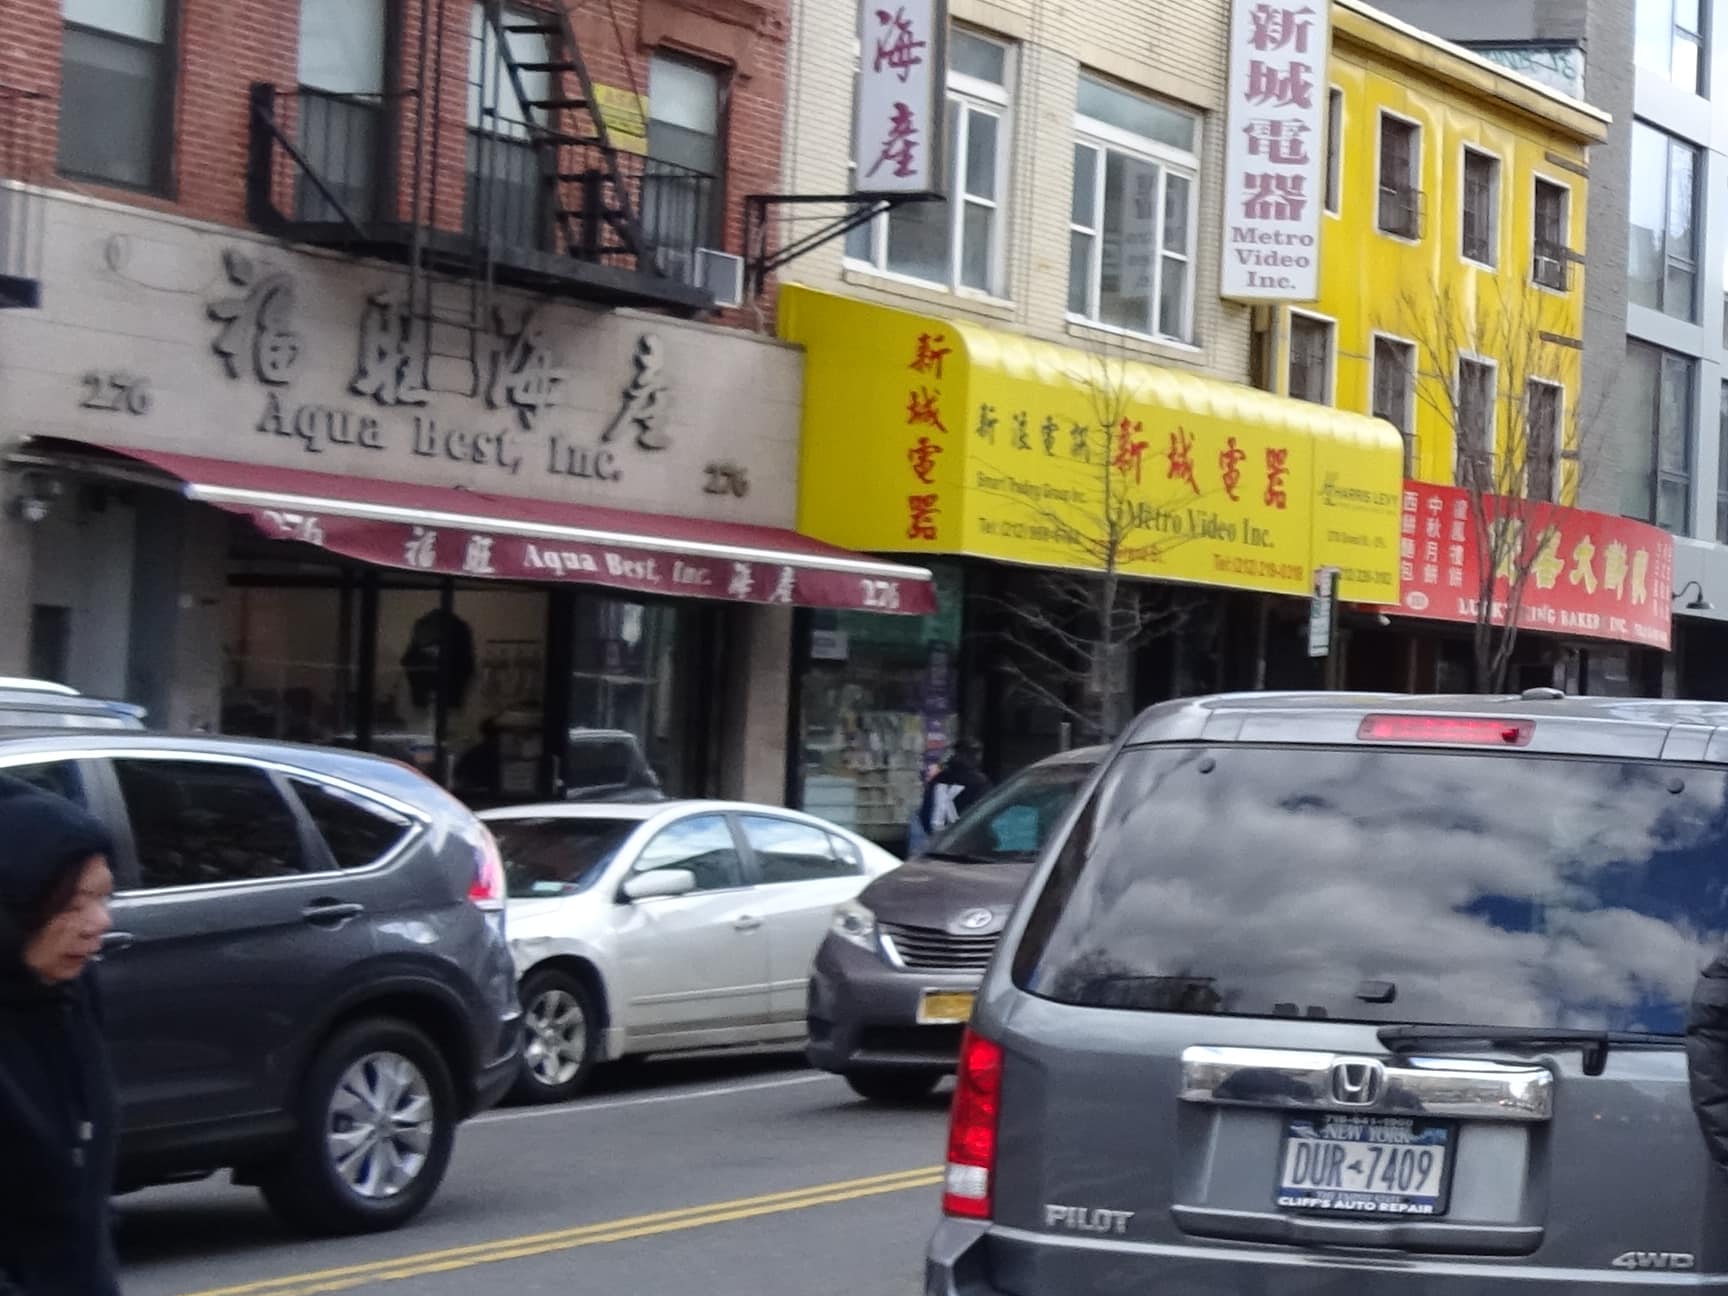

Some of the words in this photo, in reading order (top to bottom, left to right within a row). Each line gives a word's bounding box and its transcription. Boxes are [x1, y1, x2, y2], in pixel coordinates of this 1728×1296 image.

[1242, 3, 1314, 222] 新城電器
[1231, 226, 1314, 248] Metro
[1235, 249, 1310, 270] Video
[1245, 270, 1297, 292] Inc.
[80, 368, 152, 417] 276
[256, 392, 385, 454] Aqua
[413, 415, 525, 474] Best,
[547, 434, 625, 483] Inc.
[904, 331, 953, 543] 新城電器
[1112, 415, 1291, 511] 新城電器
[703, 465, 751, 500] 276
[1188, 507, 1237, 545] Video
[1243, 517, 1275, 549] Inc.
[522, 543, 598, 578] Aqua
[605, 550, 662, 583] Best,
[1325, 1123, 1362, 1140] NEW
[1367, 1125, 1413, 1144] YORK
[1291, 1141, 1346, 1187] DUR
[1364, 1145, 1434, 1192] 7409
[1044, 1203, 1135, 1236] PILOT
[1277, 1196, 1332, 1209] CLIFF'S
[1333, 1197, 1377, 1211] AUTO
[1378, 1200, 1434, 1215] REPAIR
[1611, 1249, 1695, 1271] 4WD
